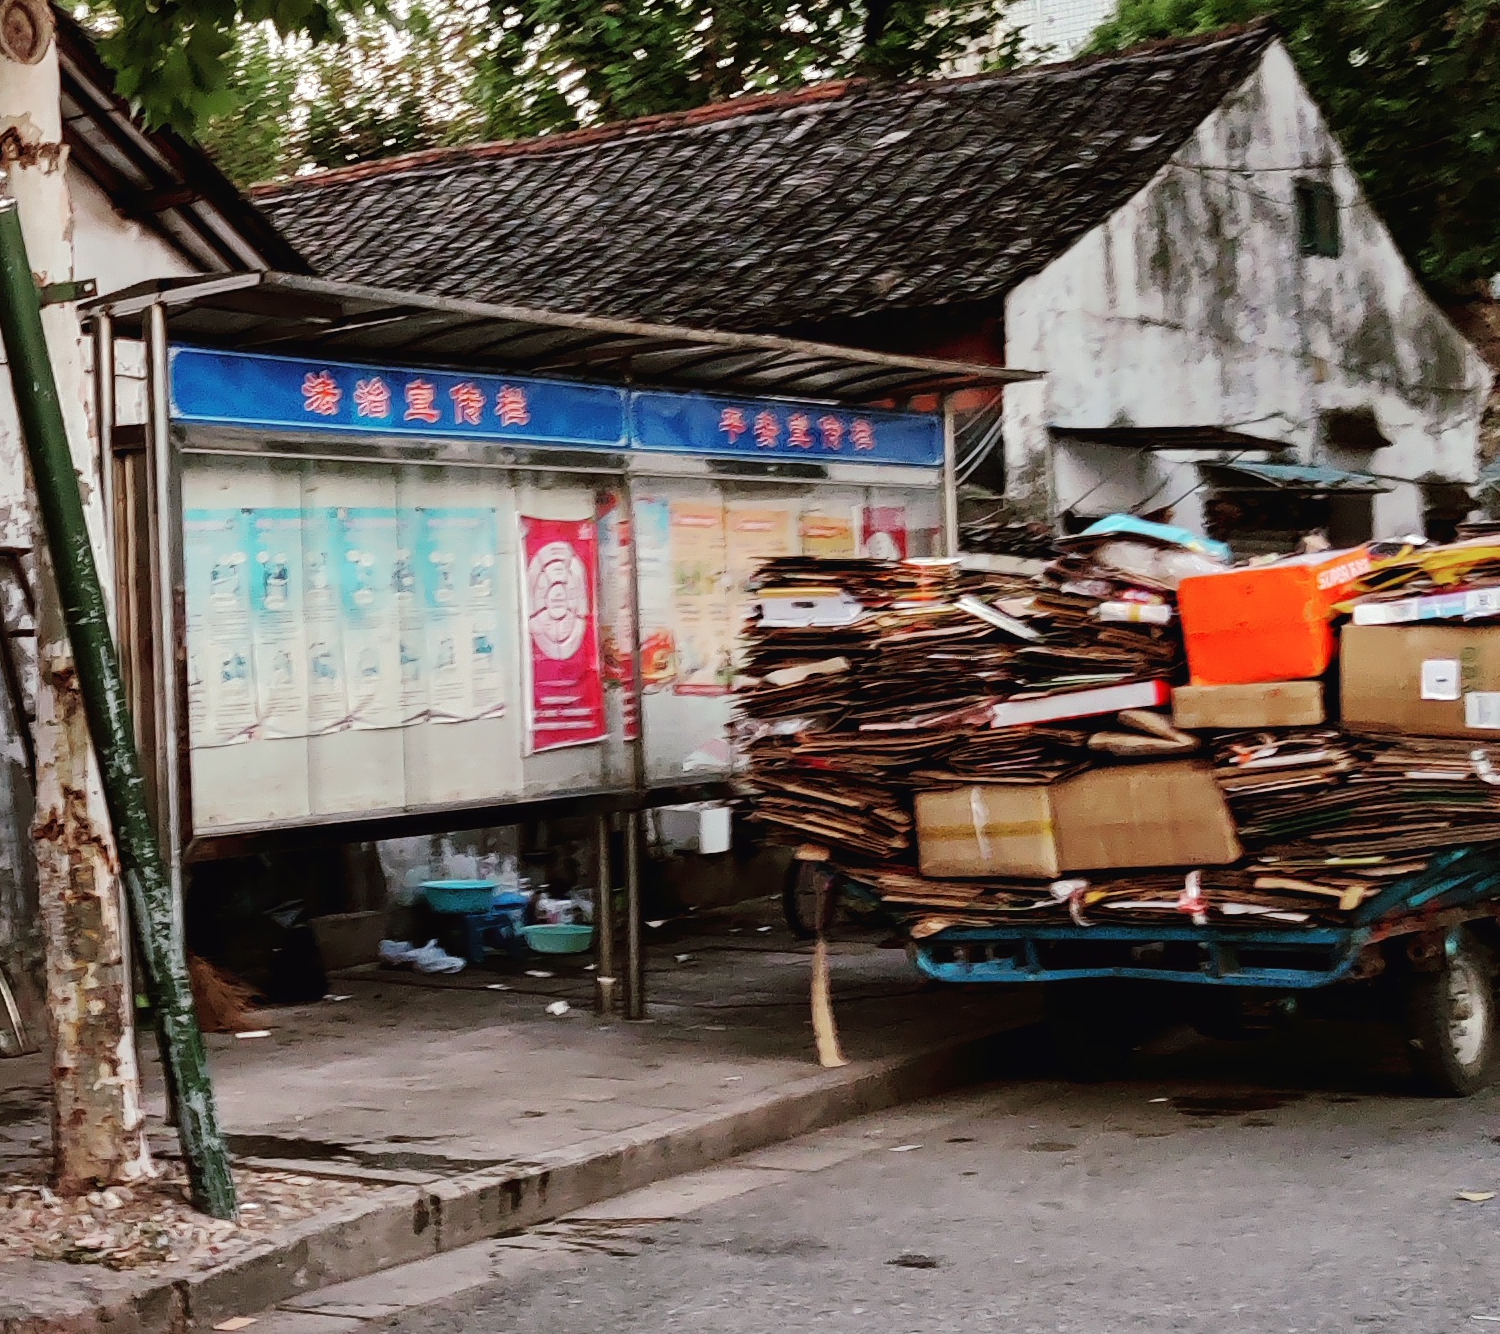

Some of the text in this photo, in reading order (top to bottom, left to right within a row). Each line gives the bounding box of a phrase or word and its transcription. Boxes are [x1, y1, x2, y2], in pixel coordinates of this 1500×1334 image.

[301, 369, 531, 428] 法治宣传栏
